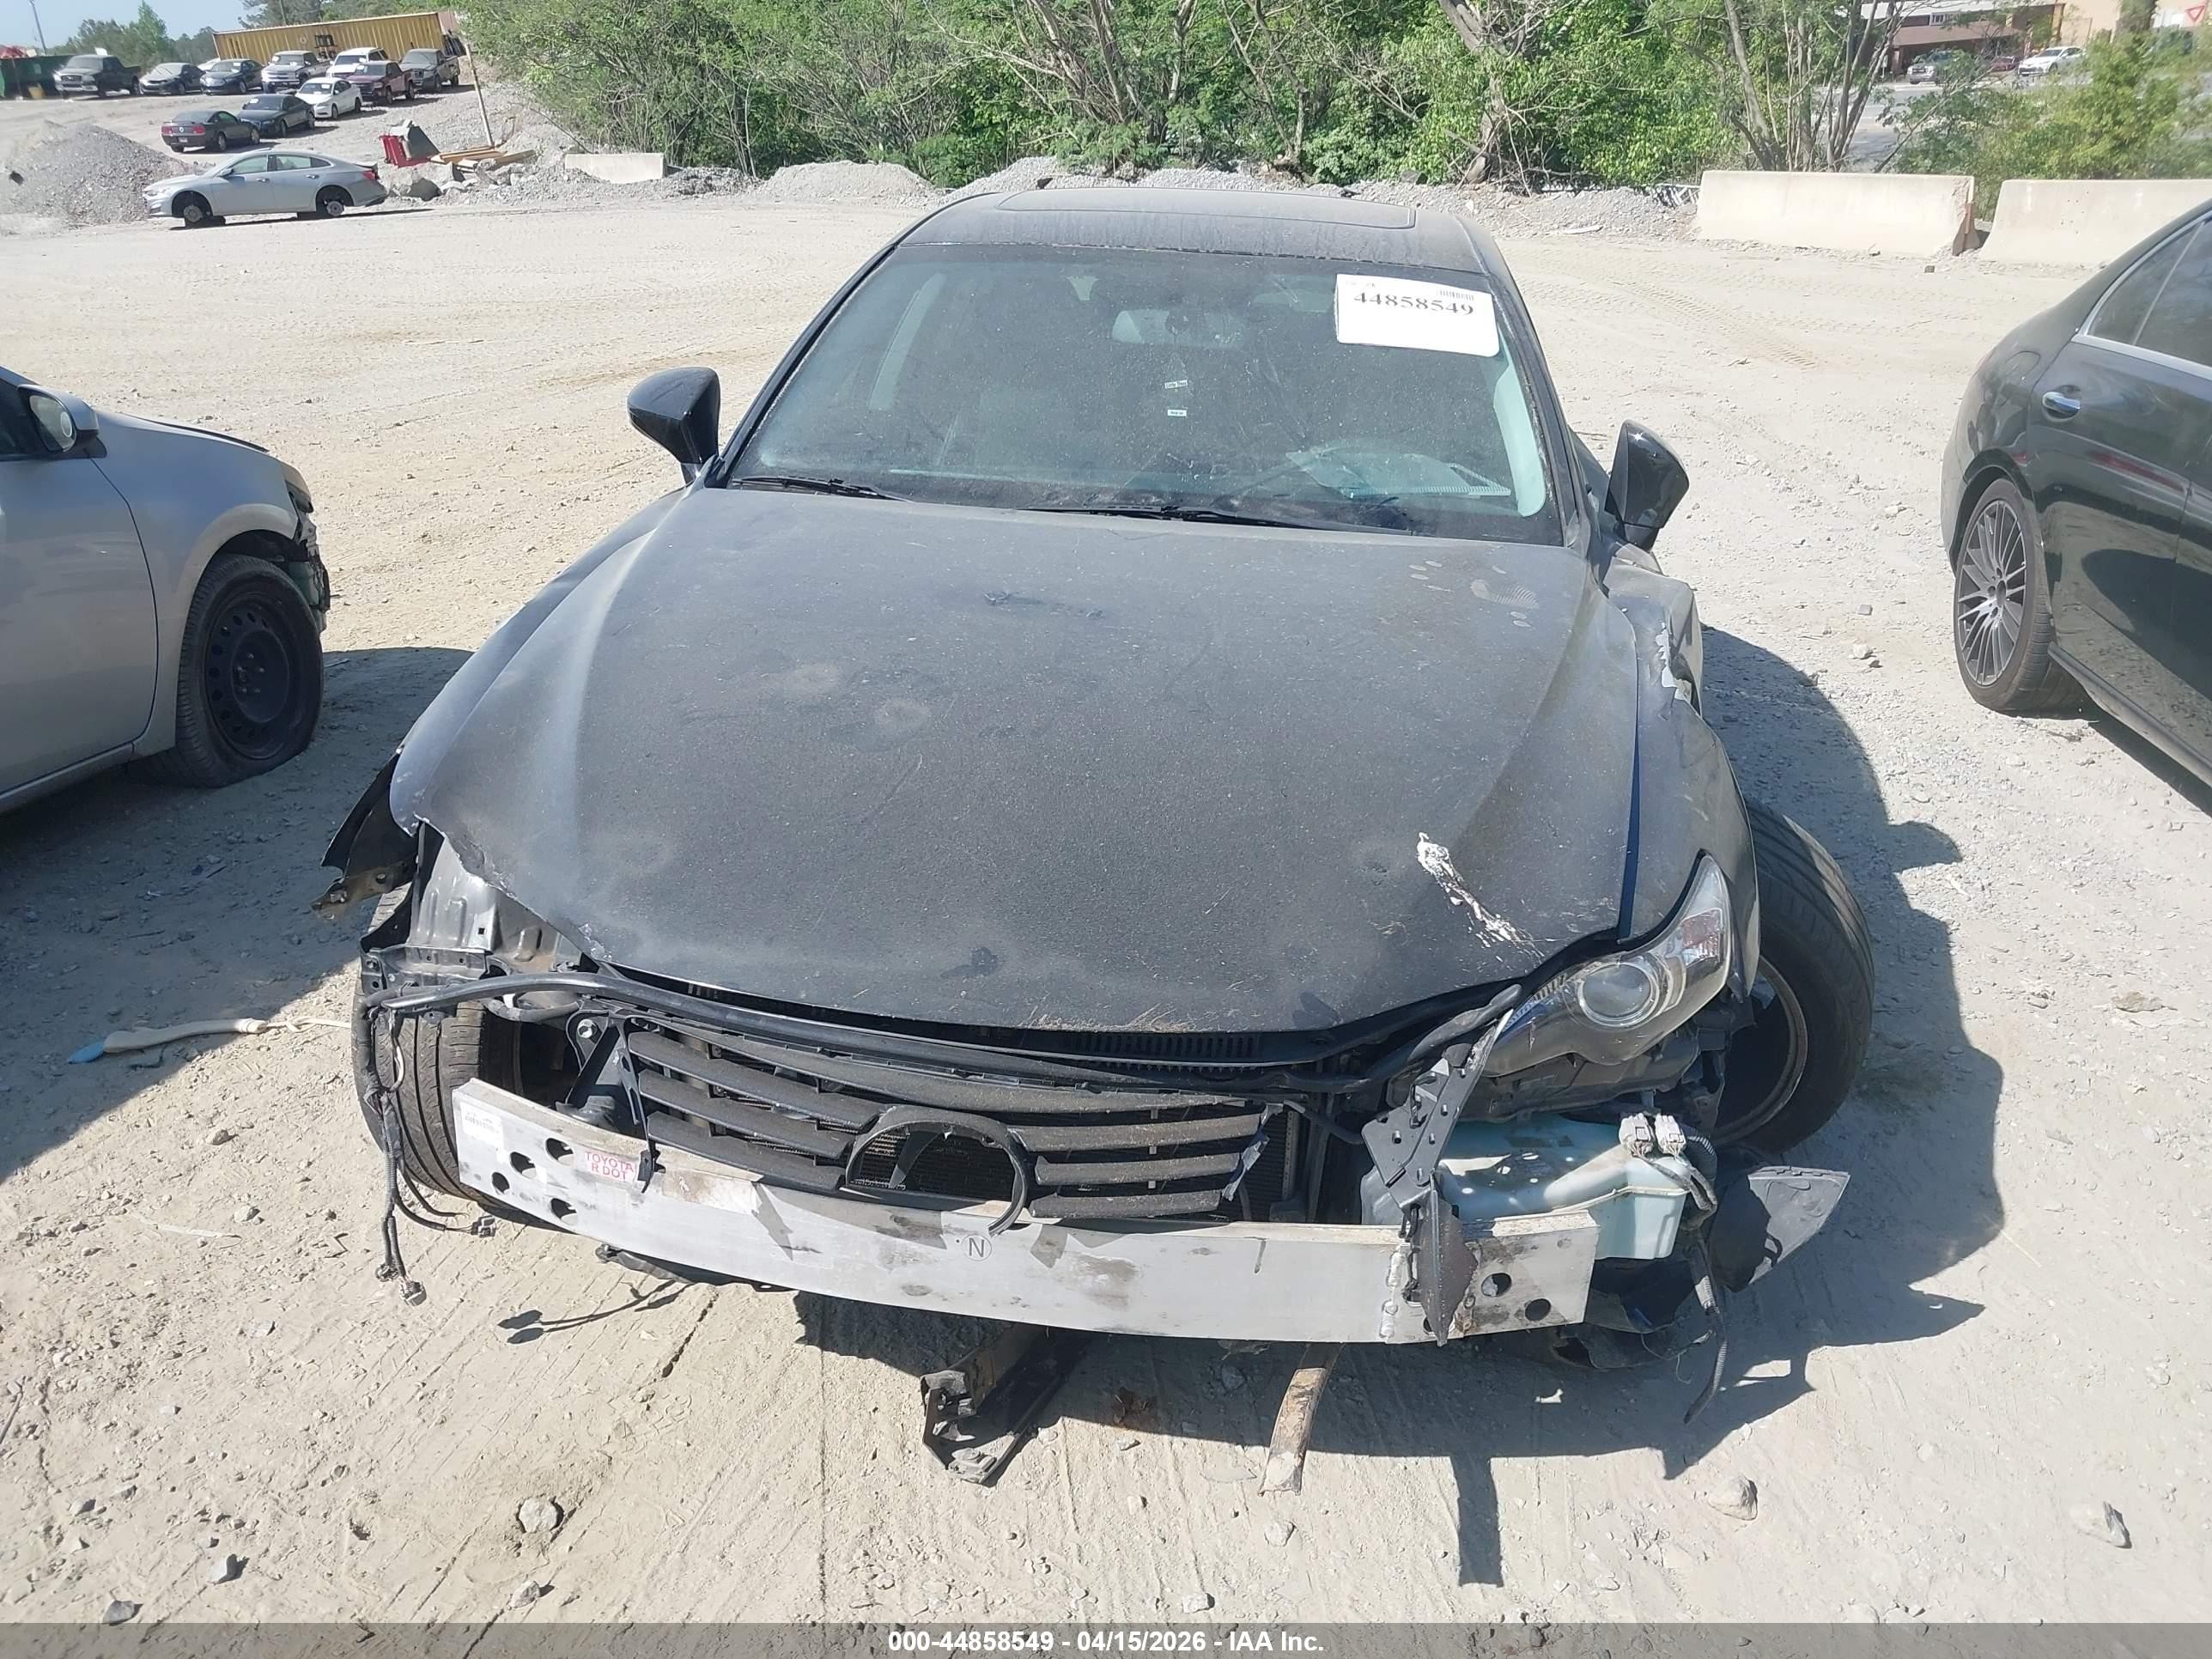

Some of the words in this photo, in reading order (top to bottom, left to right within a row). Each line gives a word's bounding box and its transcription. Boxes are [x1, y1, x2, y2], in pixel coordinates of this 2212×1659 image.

[1354, 292, 1474, 315] 44858549
[585, 1152, 634, 1172] TOYOTA
[592, 1162, 599, 1172] R
[602, 1165, 627, 1182] DOT
[969, 1237, 985, 1257] N
